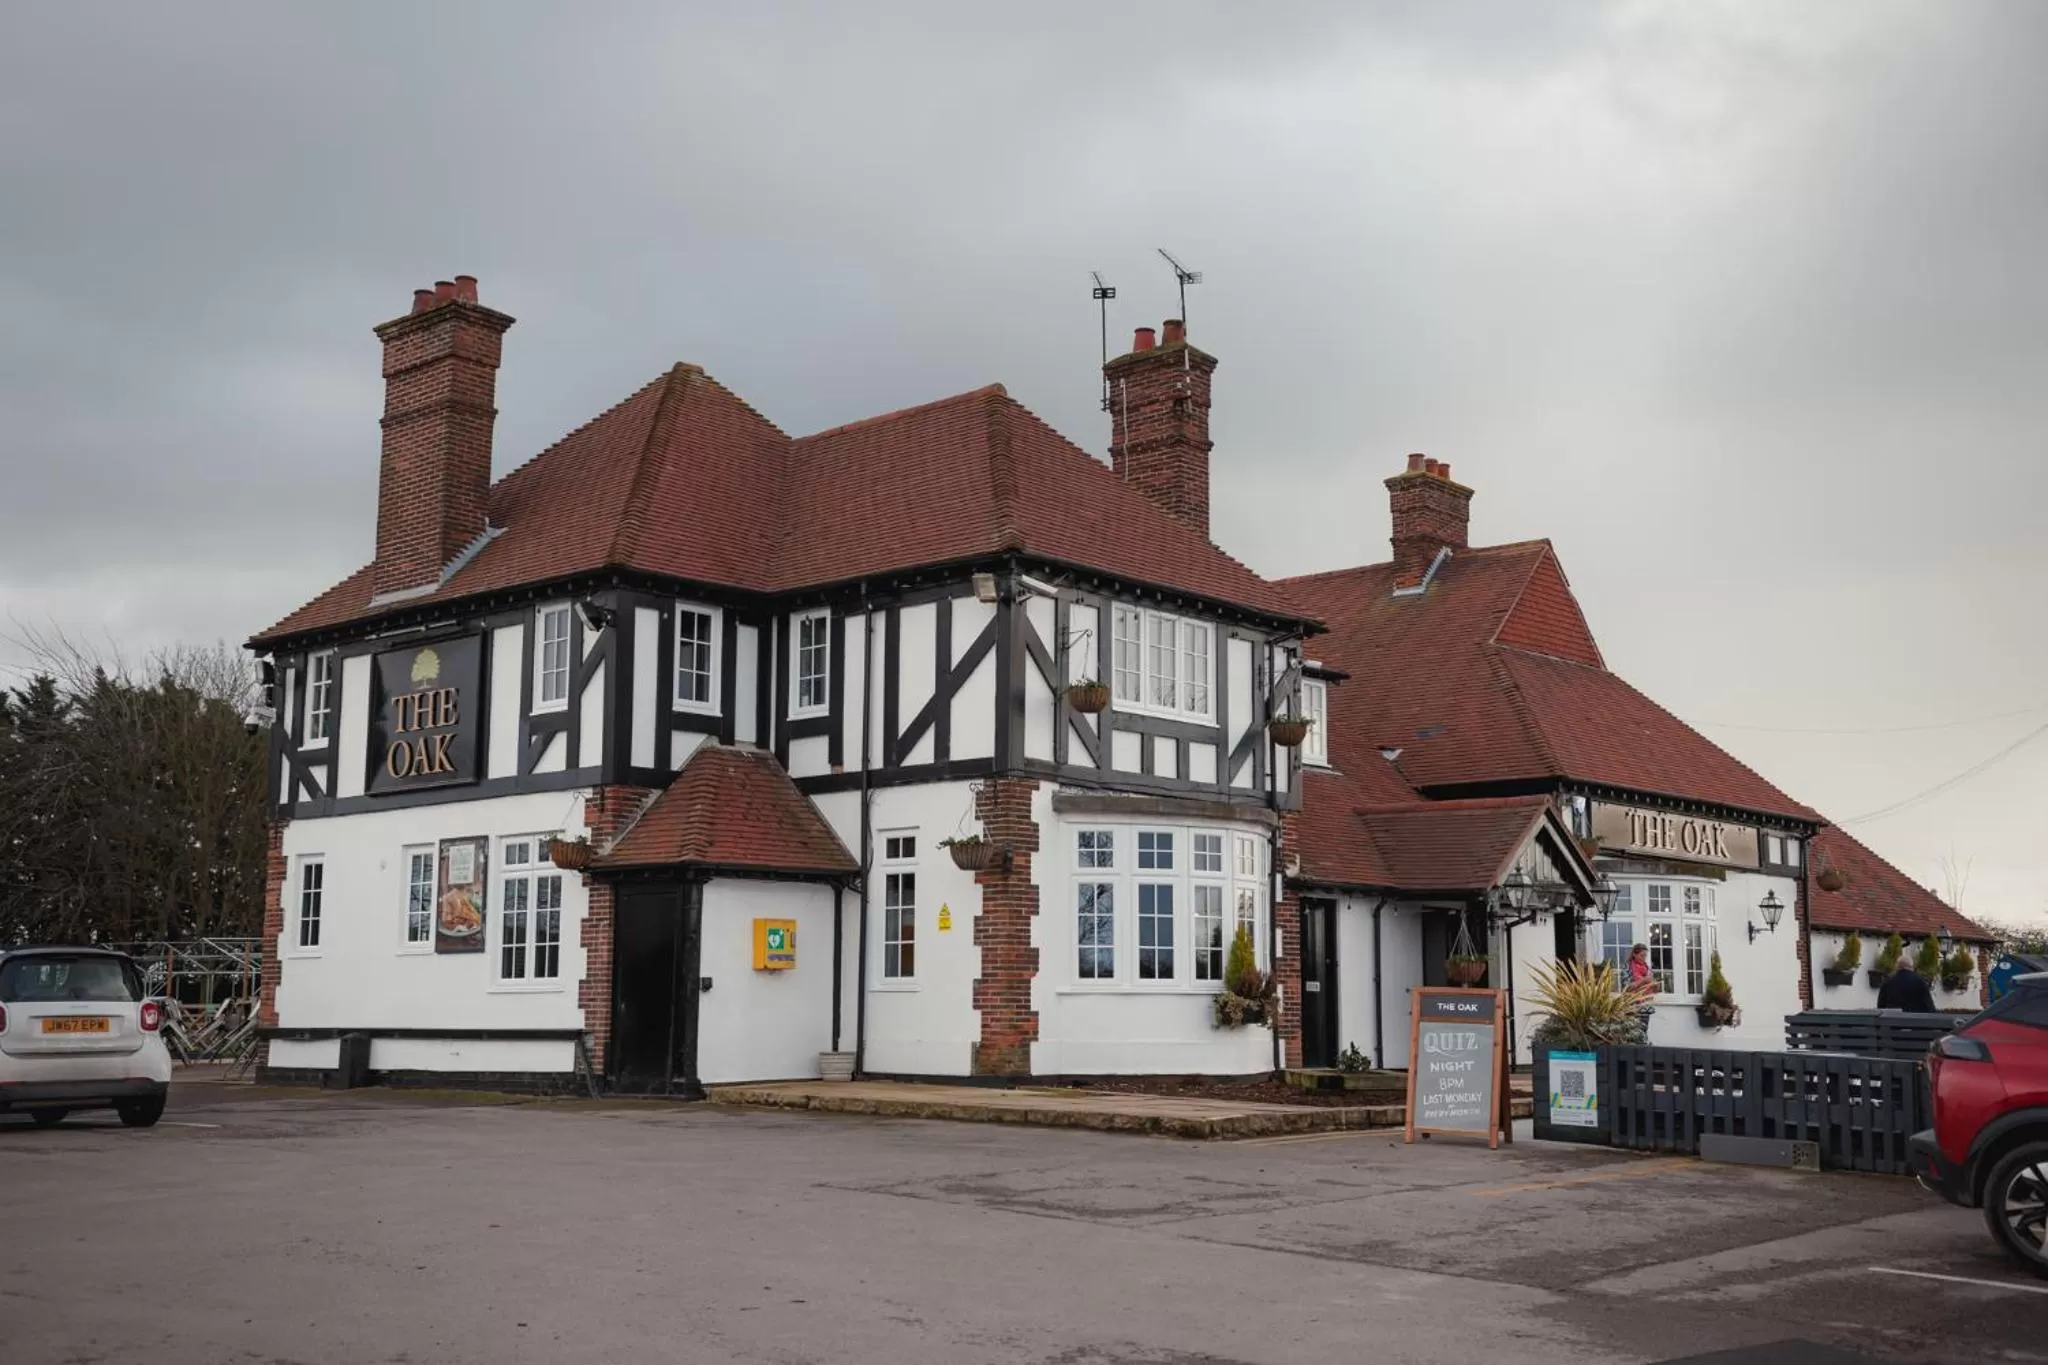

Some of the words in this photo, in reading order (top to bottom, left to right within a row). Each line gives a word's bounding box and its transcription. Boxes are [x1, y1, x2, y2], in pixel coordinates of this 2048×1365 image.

[392, 687, 459, 733] THE
[386, 733, 457, 779] OAK
[1625, 809, 1677, 850] THE
[1682, 820, 1731, 859] OAK
[1437, 1003, 1455, 1011] THE
[1458, 1004, 1478, 1012] OAK
[1424, 1032, 1478, 1056] QUIZ
[1430, 1061, 1474, 1073] NIGHT
[1439, 1077, 1464, 1090] 8PM
[1423, 1094, 1443, 1105] LAST
[1445, 1092, 1482, 1103] MONDAY
